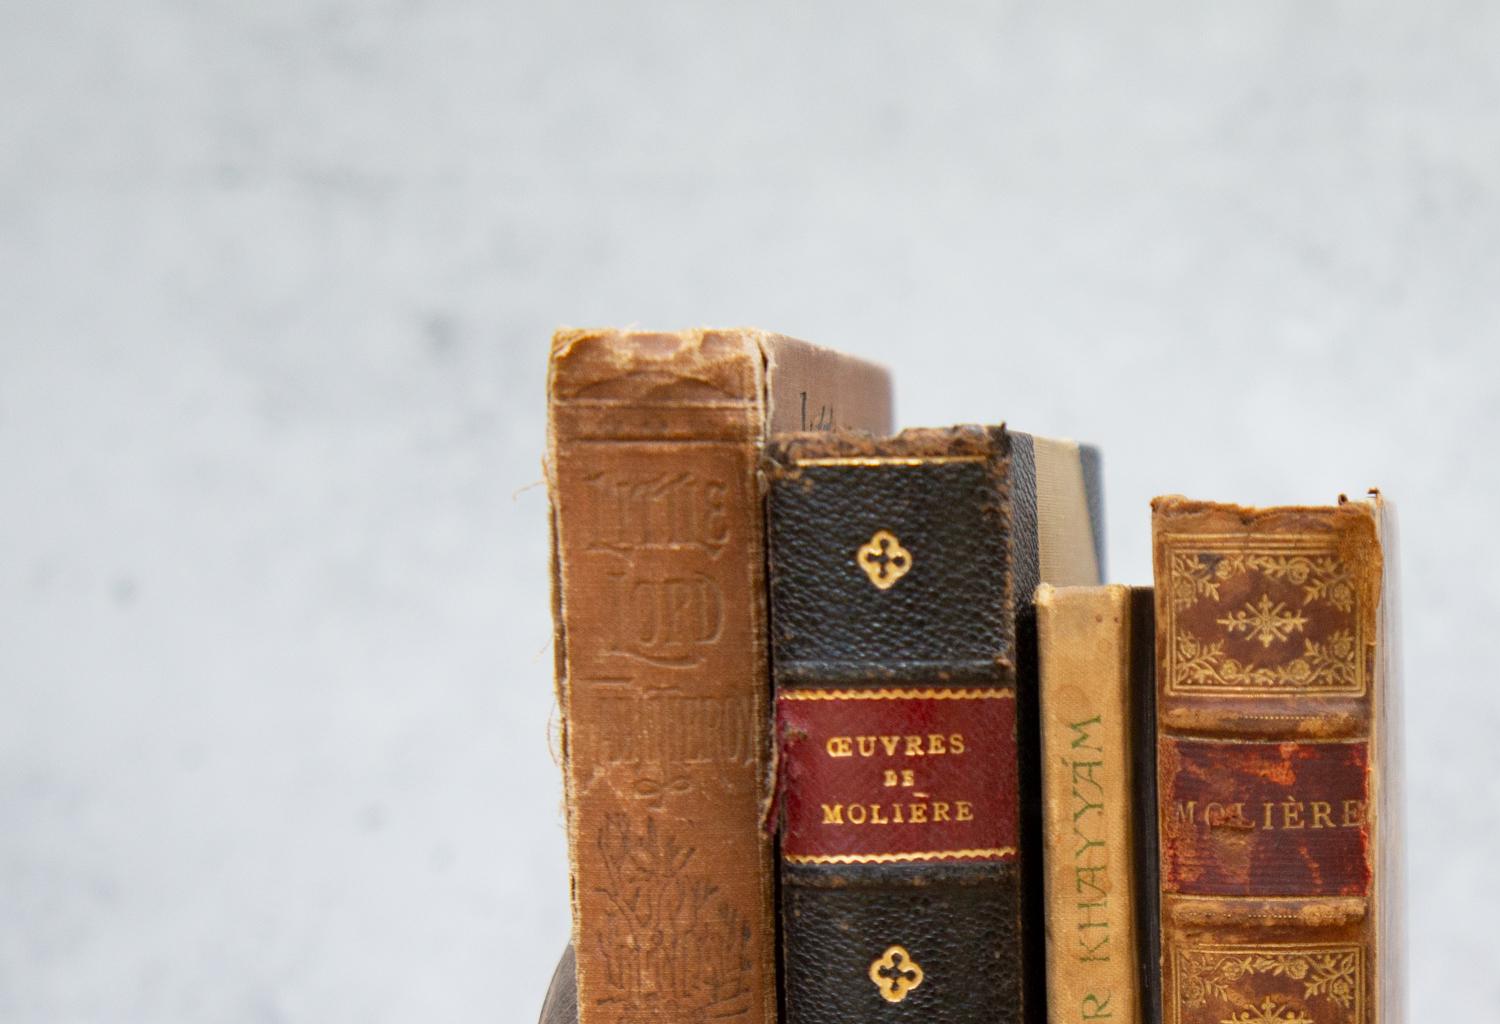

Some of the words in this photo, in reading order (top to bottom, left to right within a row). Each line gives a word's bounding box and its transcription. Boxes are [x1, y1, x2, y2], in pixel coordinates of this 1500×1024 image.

[826, 733, 966, 757] ŒUVRES
[883, 769, 915, 787] DE
[821, 791, 975, 825] MOLIÈRE
